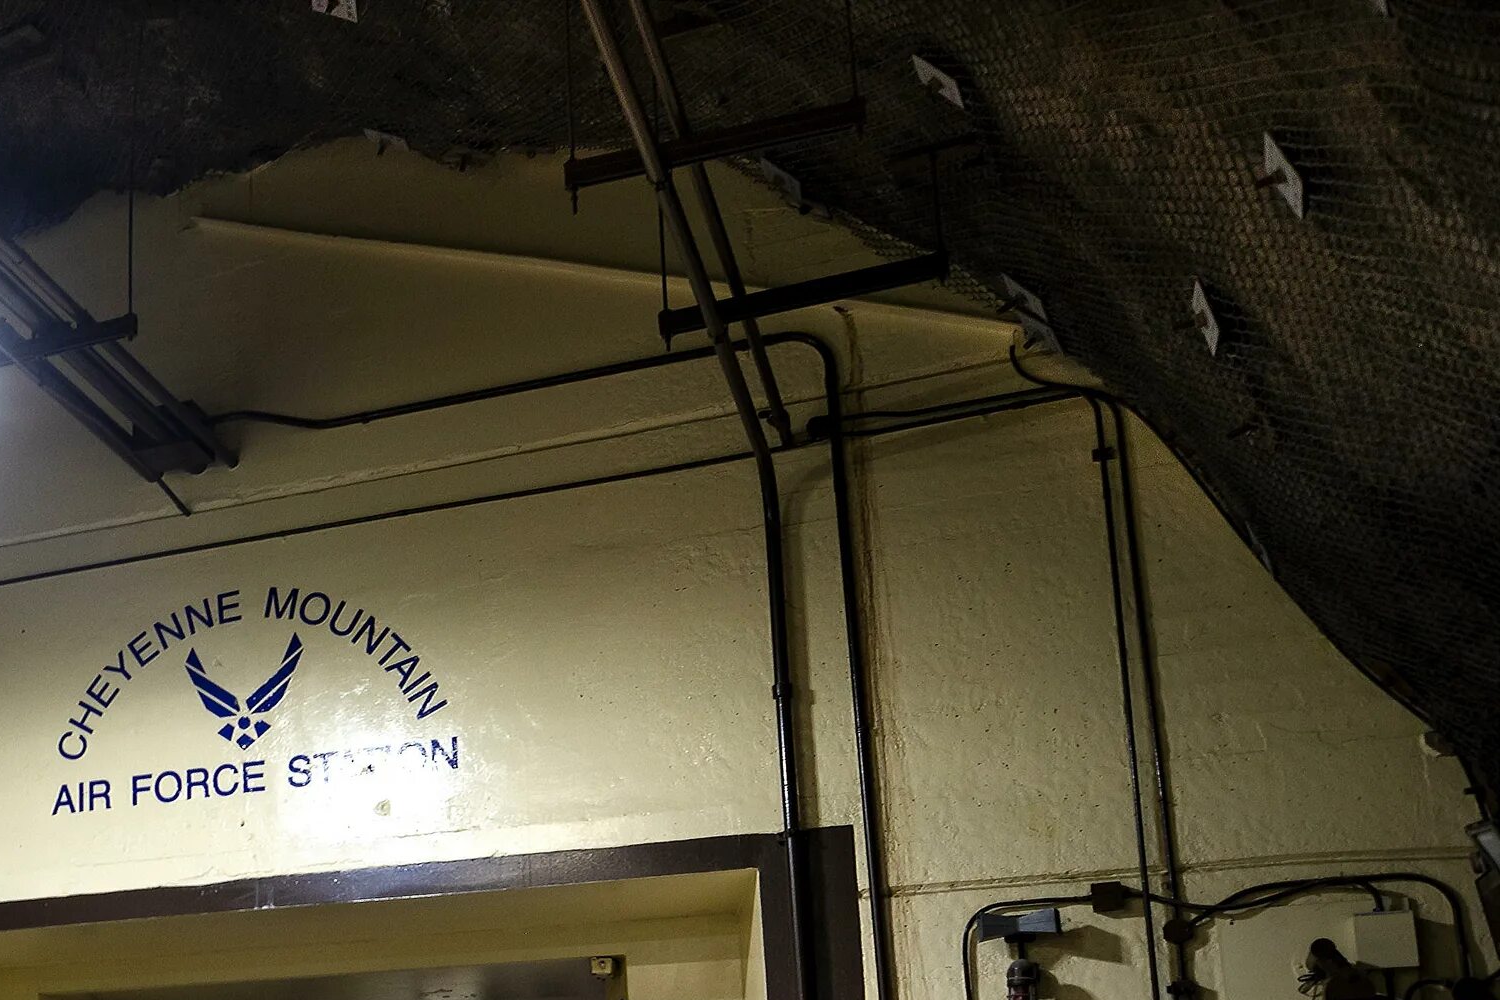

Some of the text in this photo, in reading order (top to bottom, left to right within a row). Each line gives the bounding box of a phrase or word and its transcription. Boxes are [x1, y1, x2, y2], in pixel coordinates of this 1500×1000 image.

[58, 586, 448, 761] CHEYENNE MOUNTAIN
[51, 779, 112, 816] AIR
[131, 759, 267, 807] FORCE
